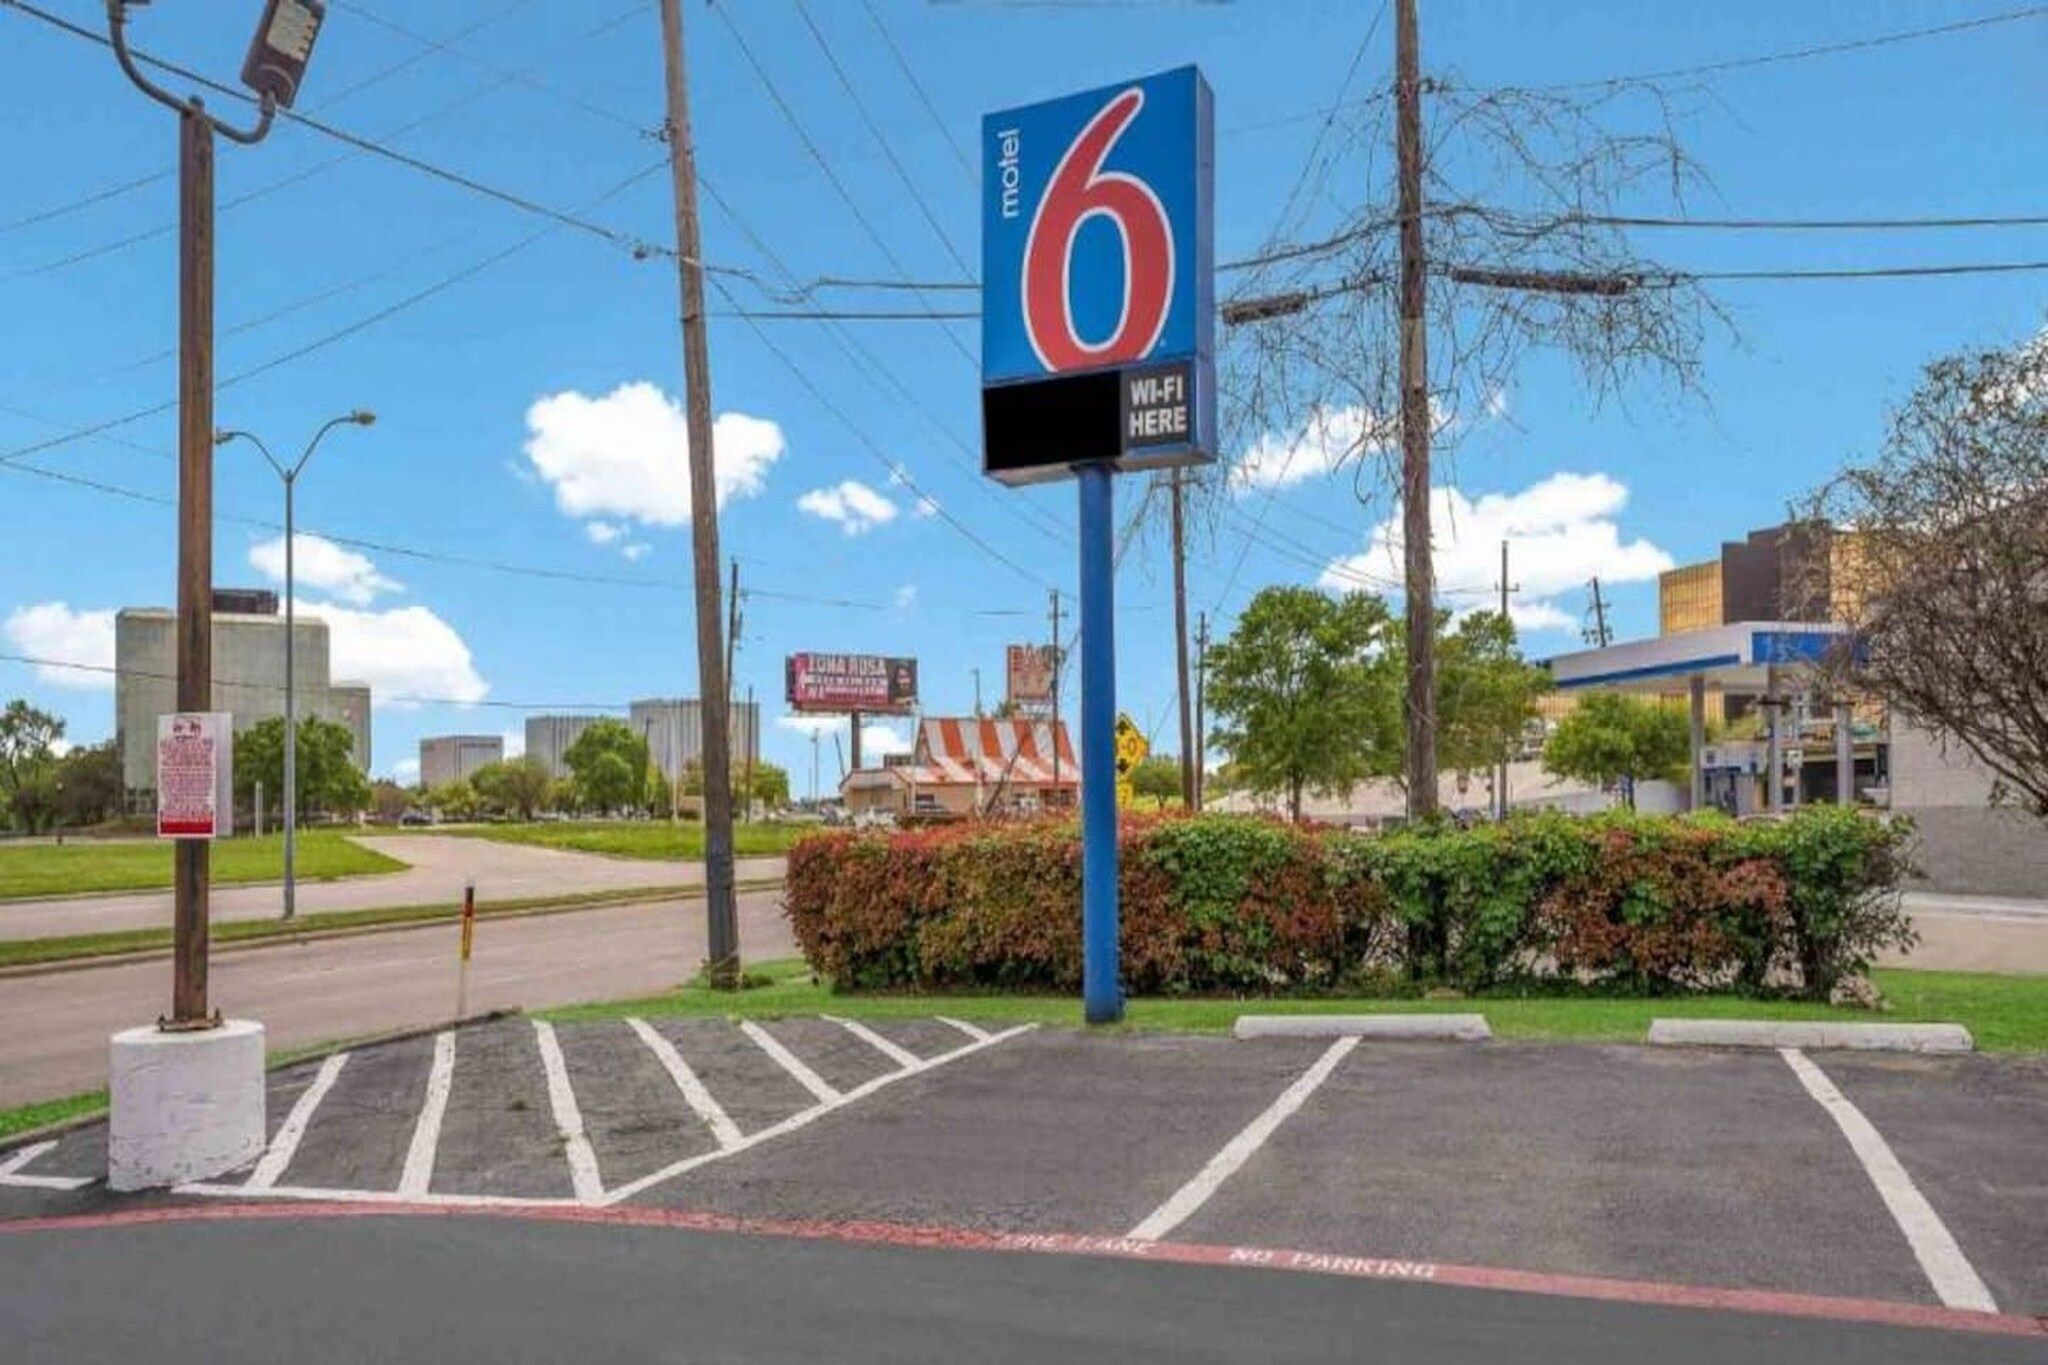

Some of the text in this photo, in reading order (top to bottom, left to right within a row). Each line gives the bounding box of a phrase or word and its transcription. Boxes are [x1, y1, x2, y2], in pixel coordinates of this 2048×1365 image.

[997, 128, 1021, 219] motel
[1021, 86, 1176, 373] 6
[1130, 374, 1184, 405] WI-FI
[1128, 406, 1187, 438] HERE
[1228, 1247, 1274, 1265] NO
[1292, 1251, 1434, 1277] PARKING
